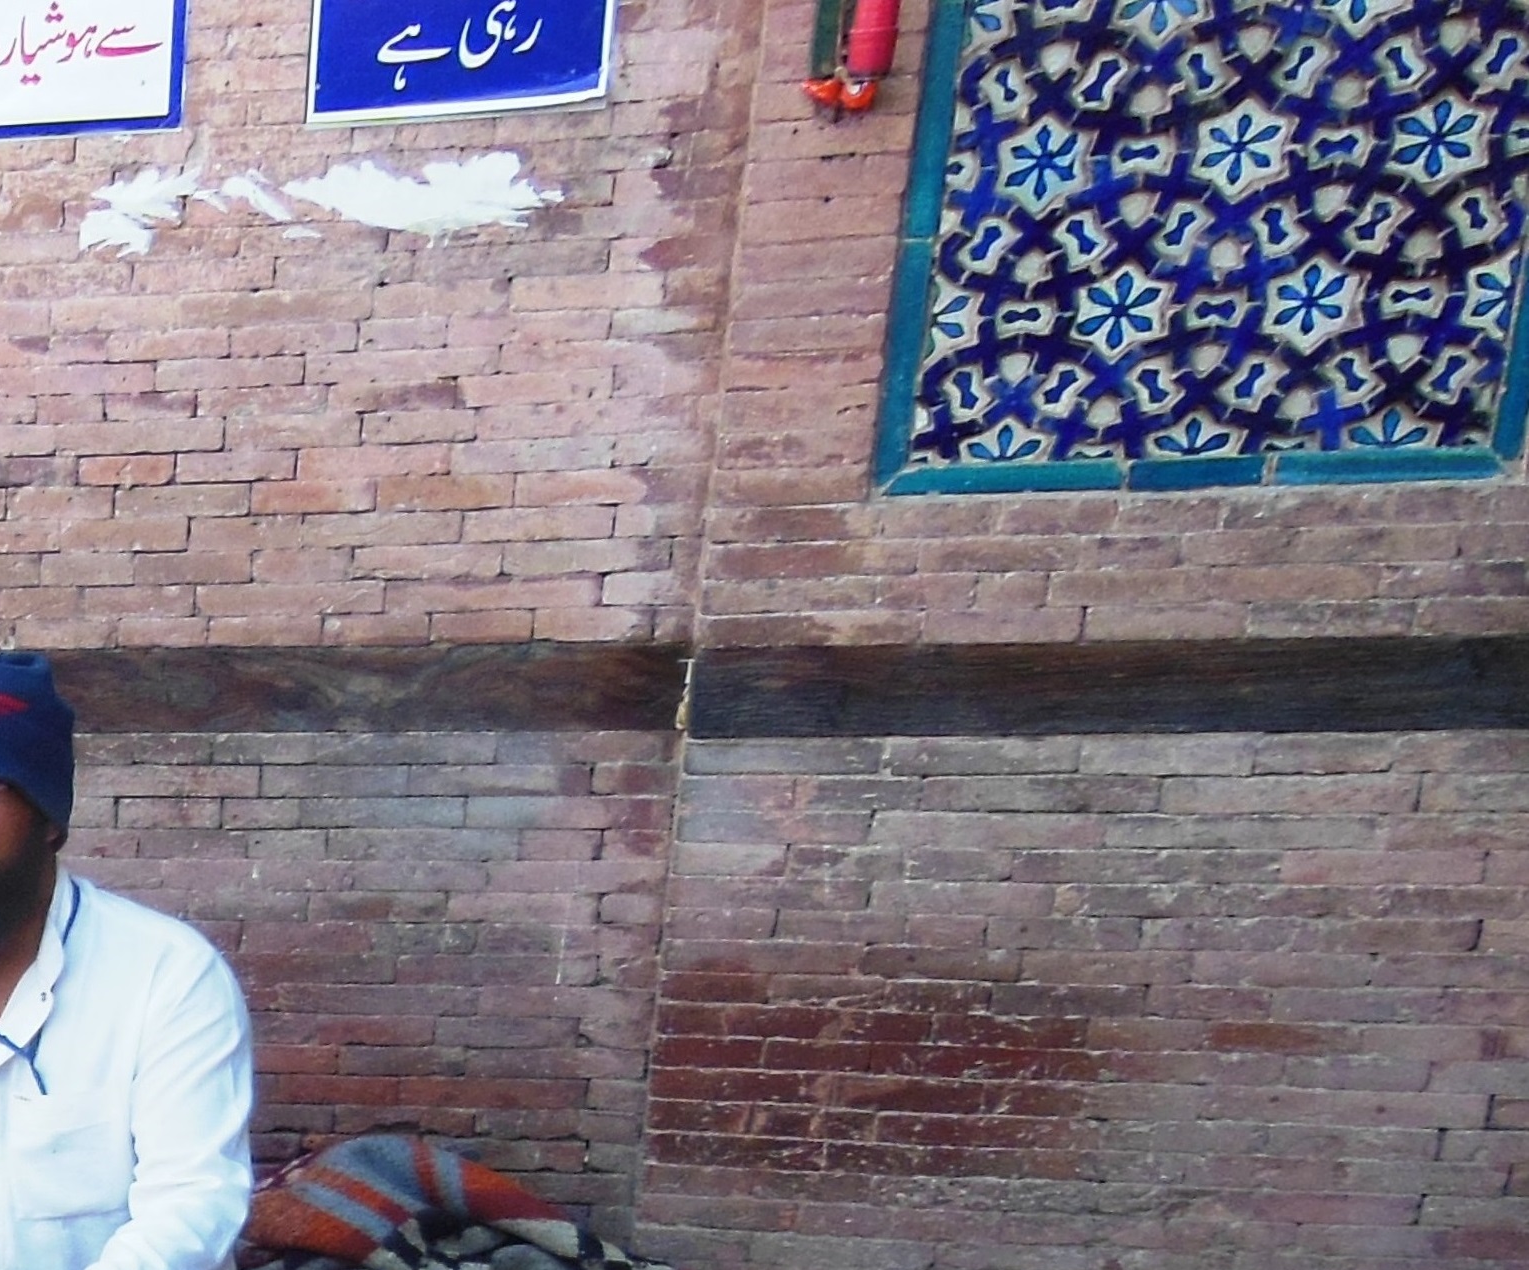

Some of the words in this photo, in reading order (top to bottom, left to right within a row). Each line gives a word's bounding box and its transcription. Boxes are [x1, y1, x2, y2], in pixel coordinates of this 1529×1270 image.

[95, 25, 163, 57] سے
[376, 23, 452, 91] ہے
[458, 0, 543, 68] رہی
